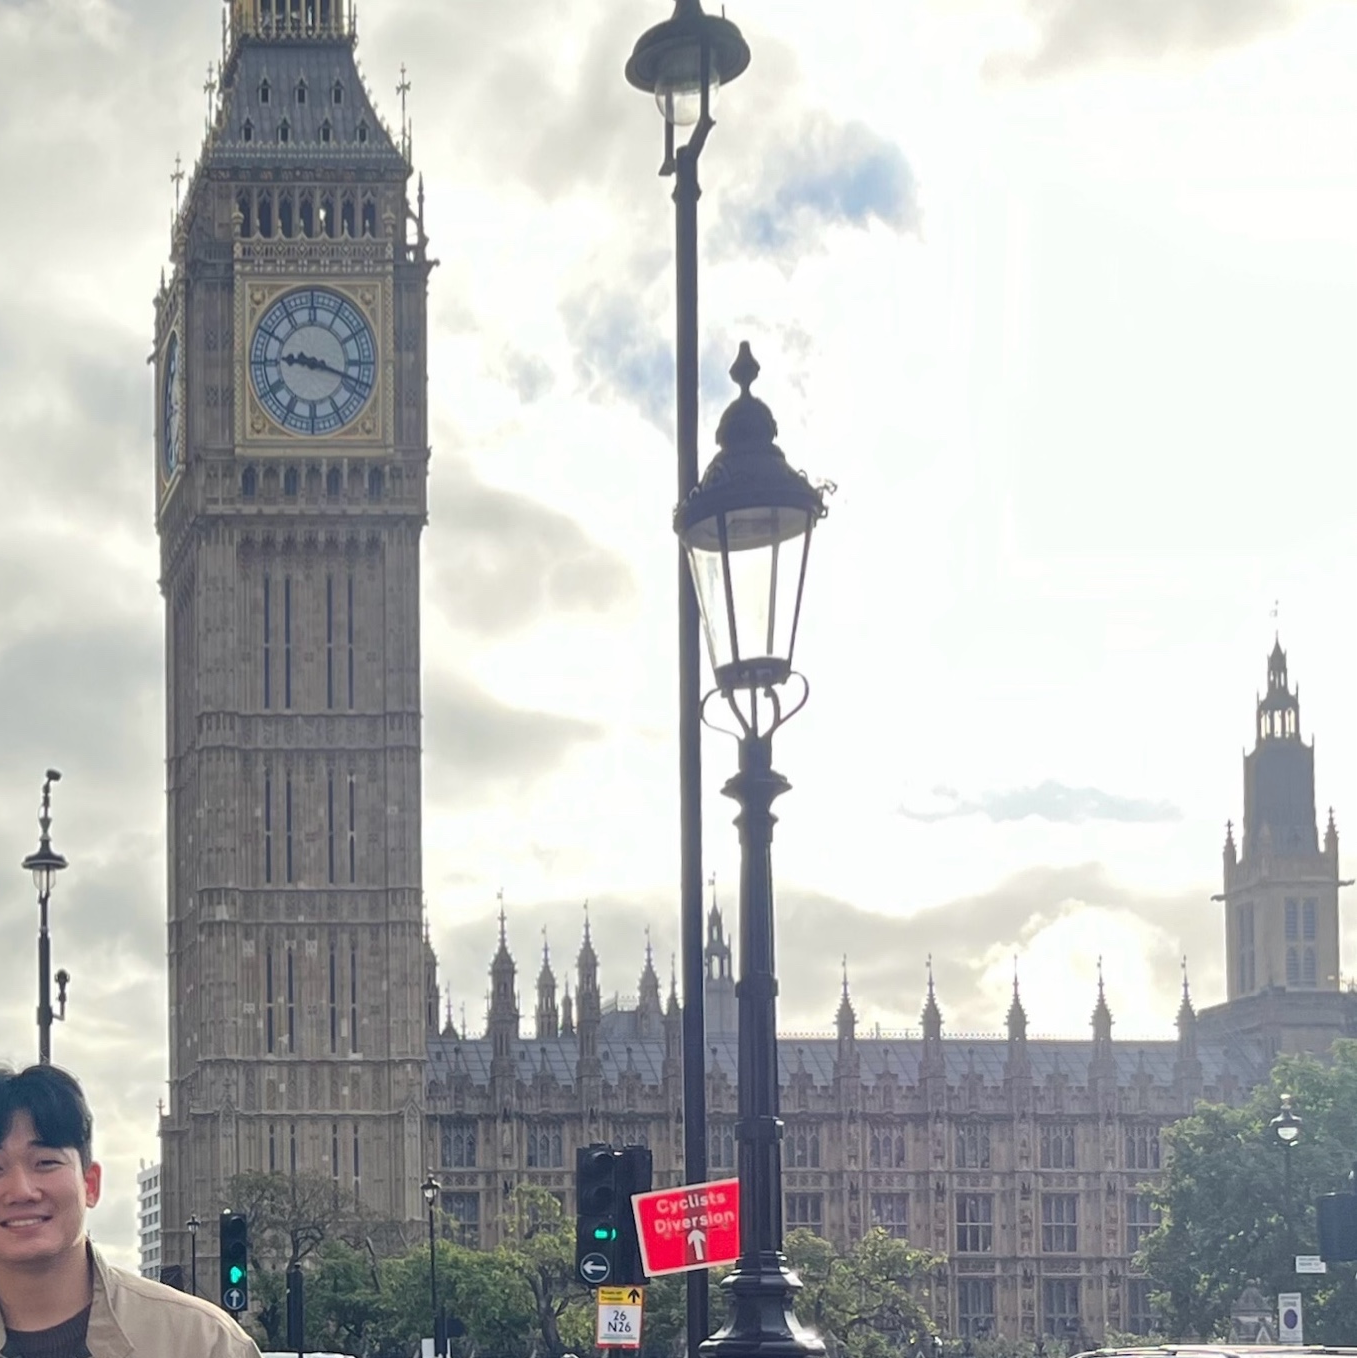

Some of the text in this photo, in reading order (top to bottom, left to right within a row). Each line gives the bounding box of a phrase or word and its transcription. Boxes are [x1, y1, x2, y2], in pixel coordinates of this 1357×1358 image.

[656, 1191, 726, 1215] Cyclists
[654, 1210, 735, 1234] Diversion
[613, 1310, 627, 1322] 26
[608, 1321, 632, 1333] N26
